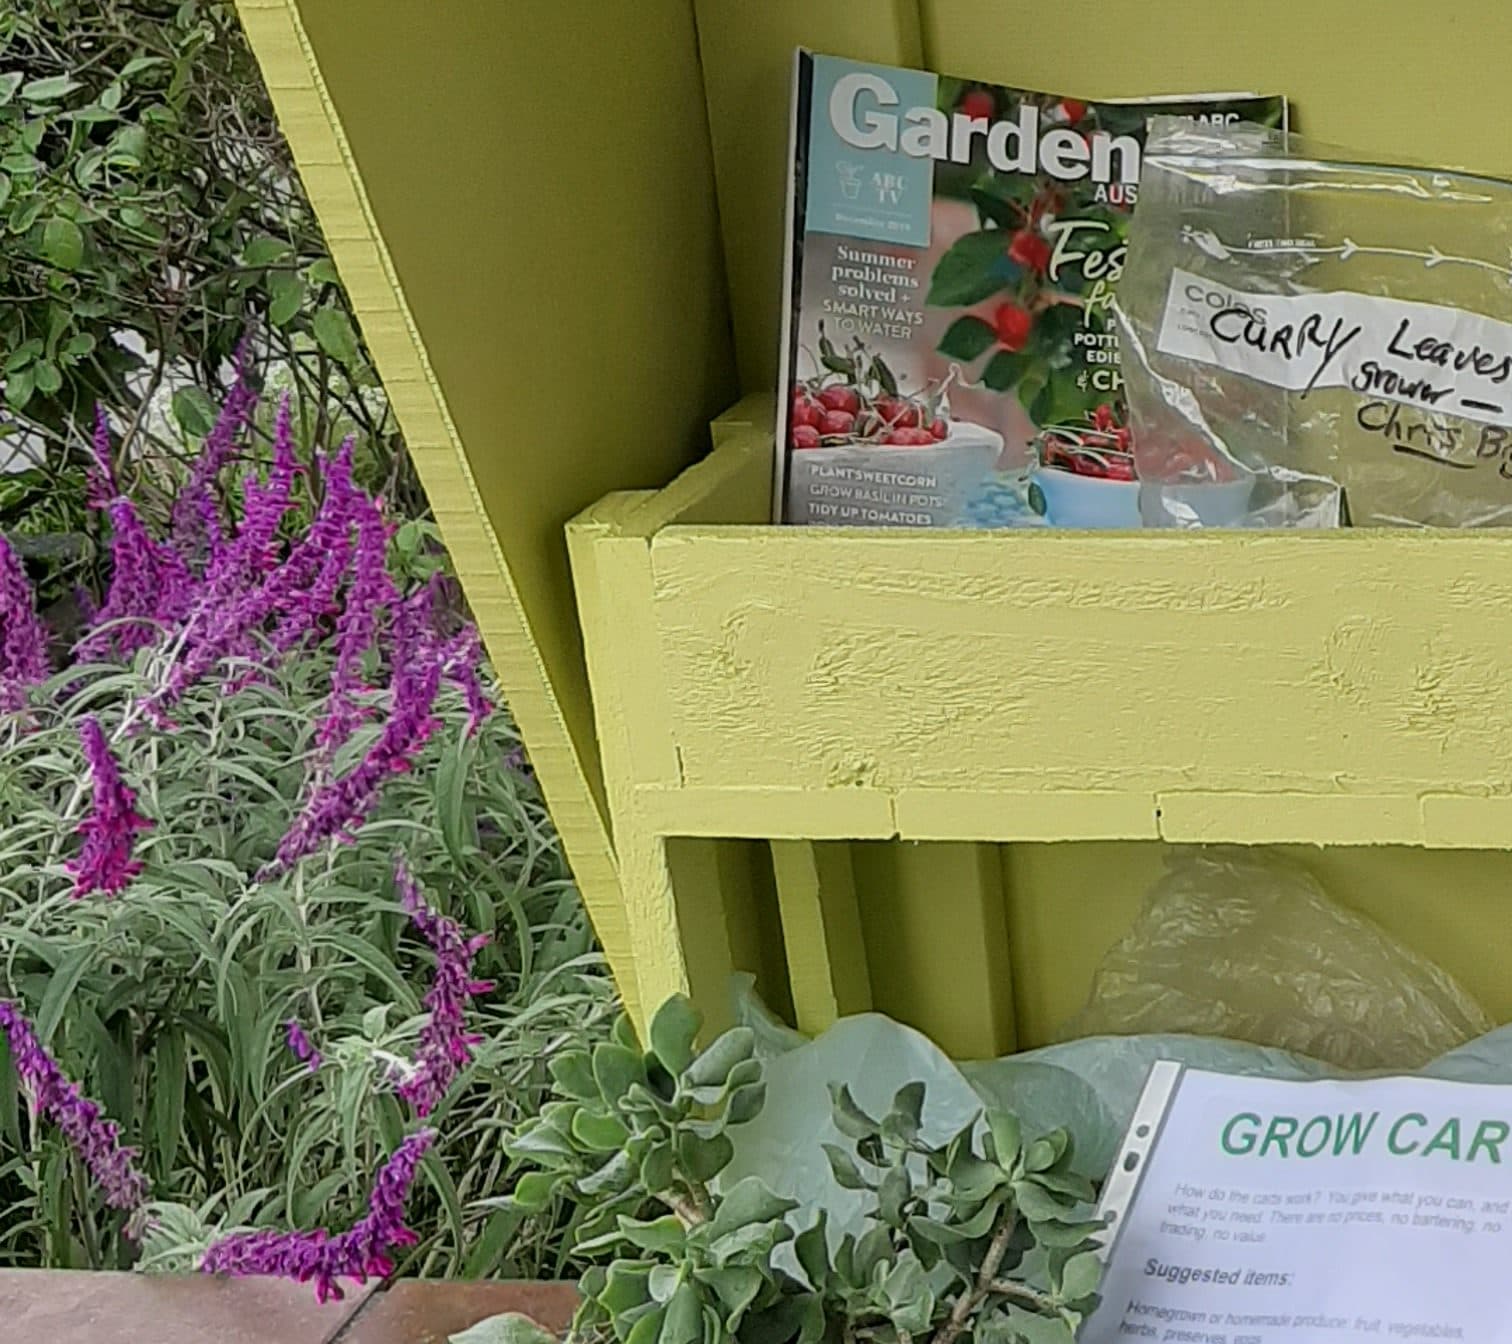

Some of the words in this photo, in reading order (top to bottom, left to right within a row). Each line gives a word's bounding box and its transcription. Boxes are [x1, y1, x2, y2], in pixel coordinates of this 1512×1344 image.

[830, 73, 1141, 184] Garden
[871, 172, 906, 190] ABC
[879, 188, 903, 204] TV
[1094, 184, 1138, 204] AUS
[837, 244, 917, 269] Summer
[832, 265, 919, 288] problems
[838, 284, 896, 303] solved
[823, 299, 879, 317] SMART
[881, 307, 924, 325] WAYS
[834, 316, 855, 331] TO
[858, 320, 912, 339] WATER
[810, 463, 854, 479] PLANT
[855, 469, 937, 488] SWEETCORN
[810, 484, 852, 499] GROW
[855, 488, 889, 504] BASIL
[808, 503, 838, 516] TIDY
[840, 506, 859, 518] UP
[861, 509, 932, 525] TOMATOES
[1219, 1111, 1378, 1160] GROW
[1174, 1182, 1204, 1199] How
[1208, 1188, 1226, 1202] do
[1229, 1190, 1250, 1204] the
[1381, 1192, 1415, 1206] what
[1417, 1194, 1442, 1210] you
[1480, 1199, 1511, 1214] and
[1168, 1203, 1201, 1219] what
[1202, 1208, 1228, 1222] you
[1269, 1209, 1304, 1224] There
[1391, 1212, 1408, 1225] no
[1482, 1221, 1502, 1233] no
[1213, 1229, 1230, 1241] no
[1143, 1257, 1242, 1286] Suggested
[1243, 1268, 1295, 1287] items:
[1125, 1299, 1207, 1323] Homegrown
[1208, 1312, 1224, 1325] or
[1225, 1312, 1291, 1328] homemade
